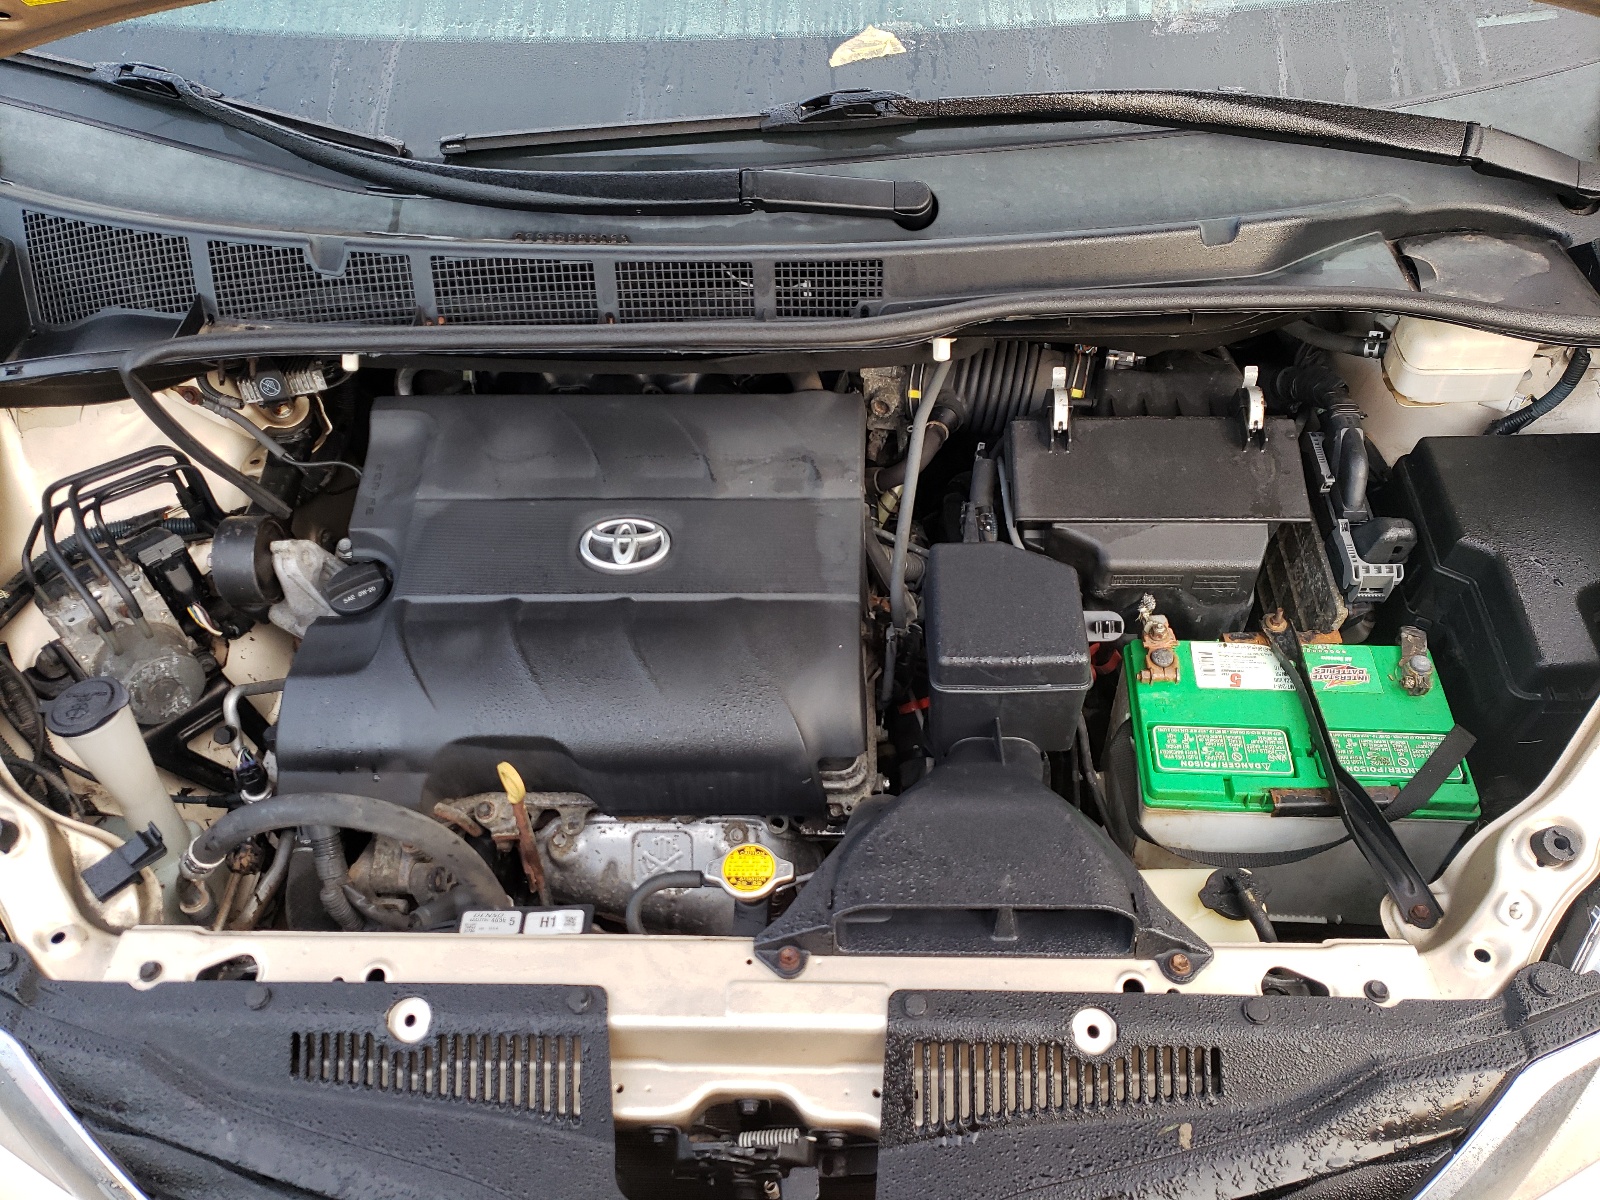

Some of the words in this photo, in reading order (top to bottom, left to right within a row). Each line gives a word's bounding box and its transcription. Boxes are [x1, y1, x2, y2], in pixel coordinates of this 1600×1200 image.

[1314, 668, 1365, 676] BATTERIES
[1229, 673, 1242, 688] 5
[1312, 674, 1369, 682] INTERSTATE
[1180, 760, 1261, 769] DANGER/POISON
[1346, 765, 1421, 774] ANGER/POISON
[509, 916, 516, 926] 5
[539, 915, 557, 928] H1
